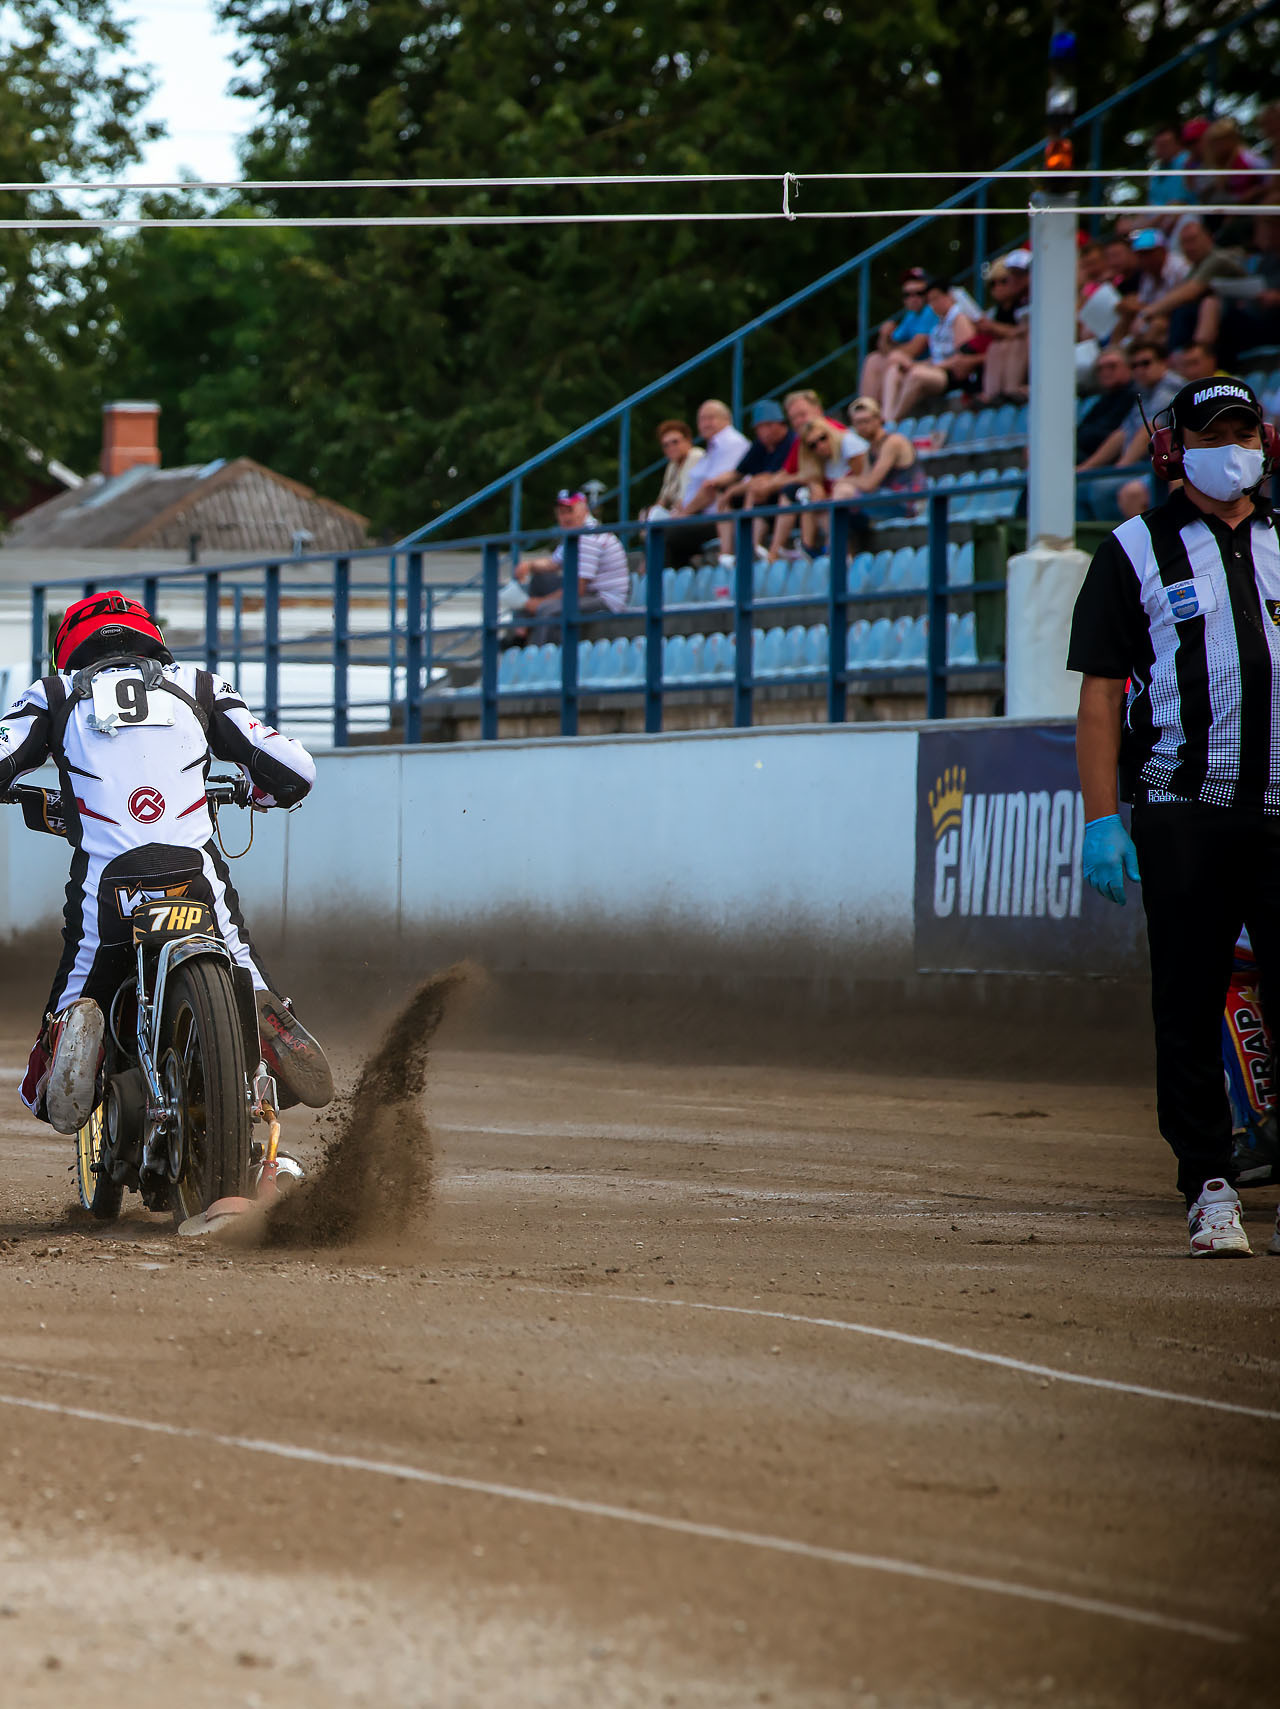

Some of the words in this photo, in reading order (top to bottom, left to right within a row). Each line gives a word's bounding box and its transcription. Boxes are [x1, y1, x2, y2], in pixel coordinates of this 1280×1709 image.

[1193, 385, 1252, 405] MARSHAL
[115, 678, 149, 723] 9
[148, 906, 203, 932] 7KP
